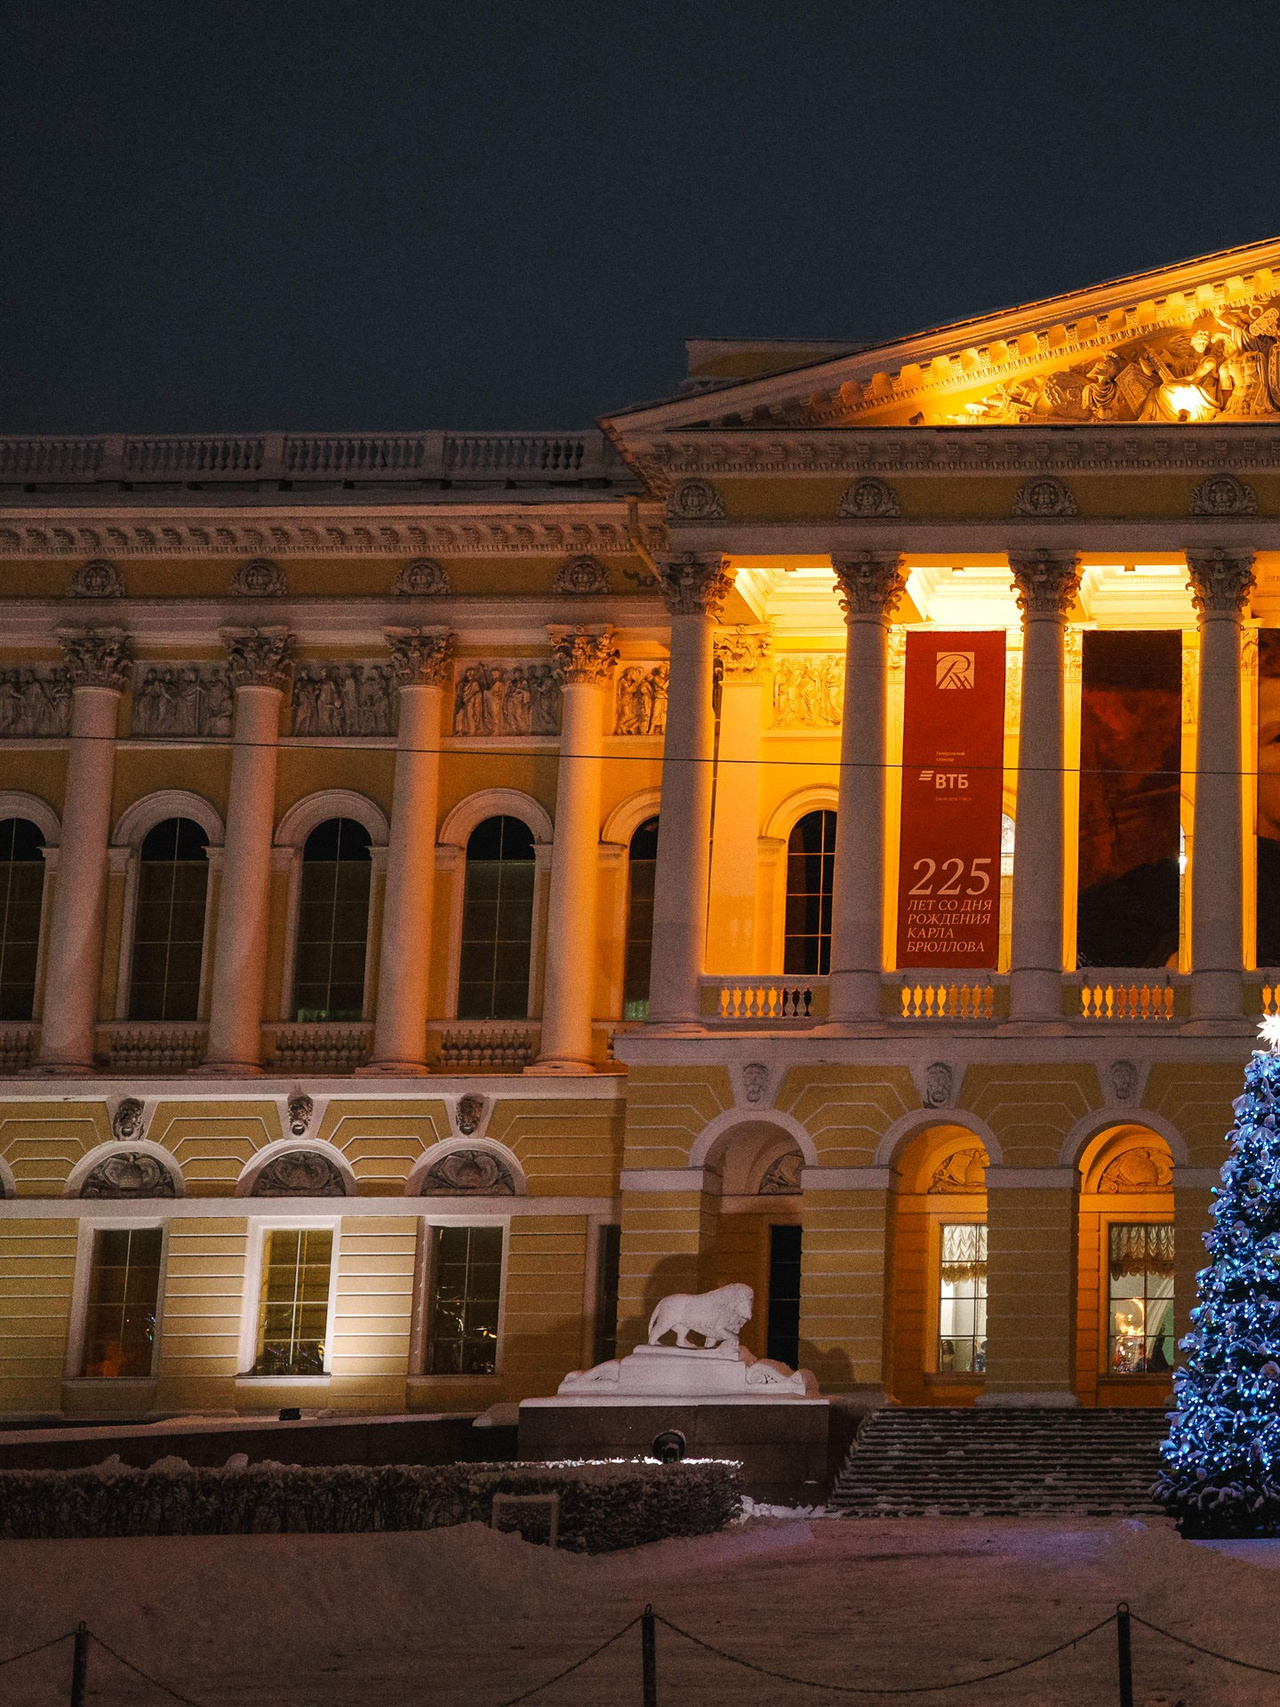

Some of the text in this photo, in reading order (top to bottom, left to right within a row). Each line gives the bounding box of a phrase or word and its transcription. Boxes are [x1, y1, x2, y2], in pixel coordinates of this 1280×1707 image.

[935, 773, 969, 789] ВТБ
[908, 858, 992, 896] 225
[907, 899, 993, 913] ЛЕТ СО ДНЯ
[907, 913, 992, 926] РОЖДЕНИЯ
[907, 927, 954, 939] КАРЛА
[906, 940, 985, 953] БРЮЛЛОВА
